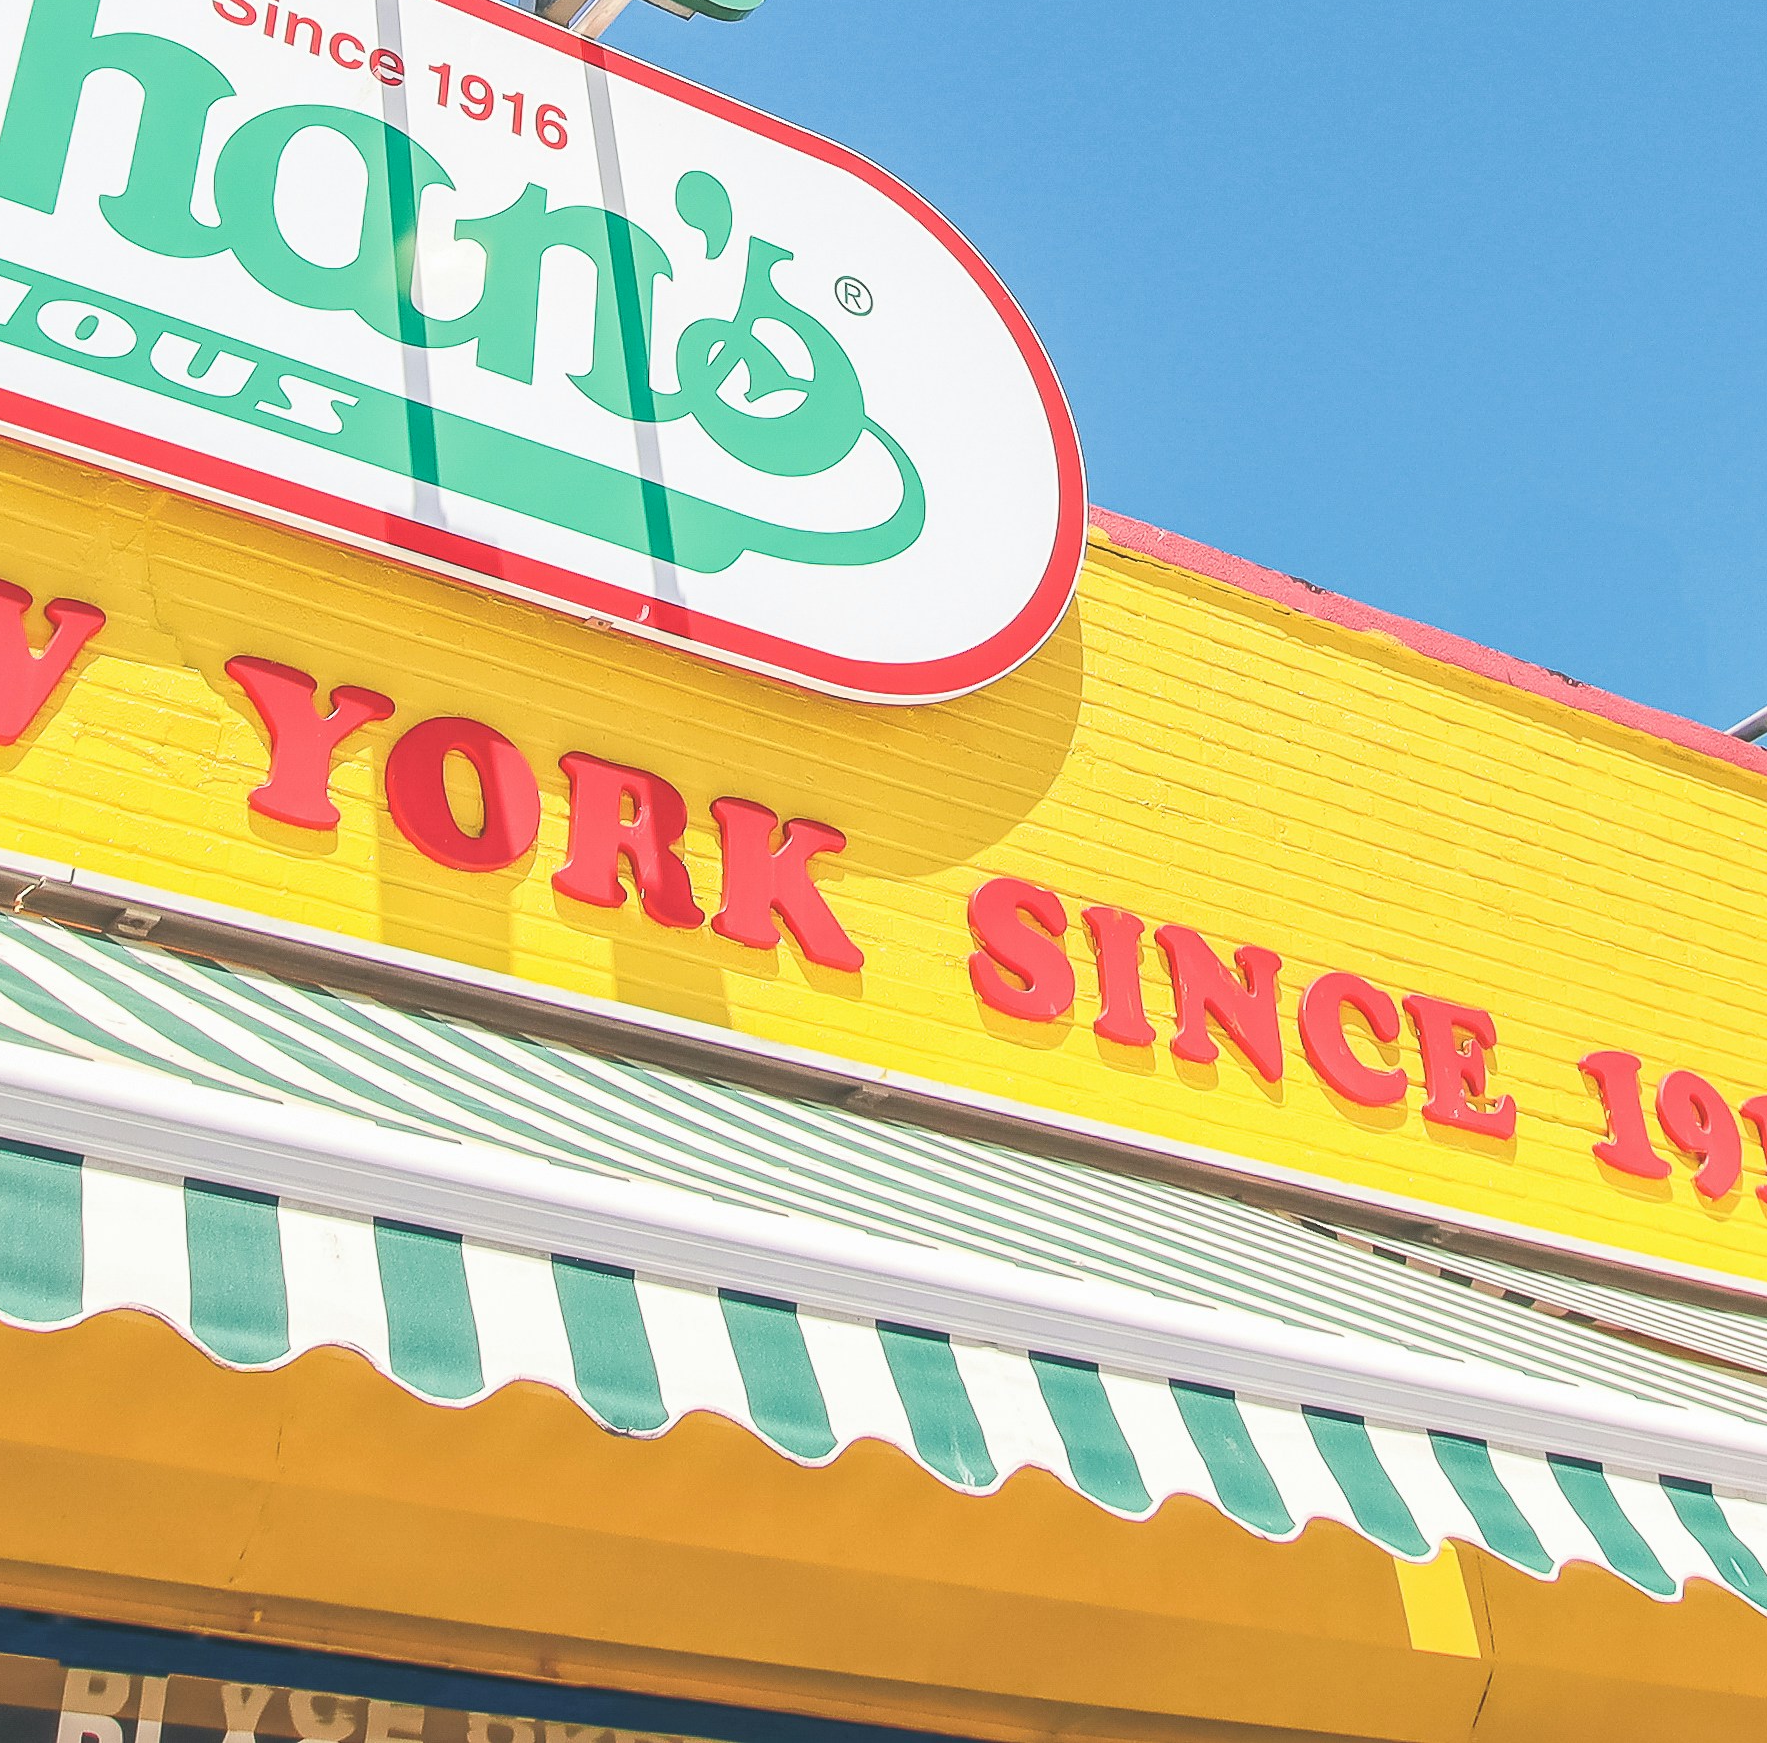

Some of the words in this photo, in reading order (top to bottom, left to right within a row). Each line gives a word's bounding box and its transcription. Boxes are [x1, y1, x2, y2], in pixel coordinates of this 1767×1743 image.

[427, 61, 569, 151] 1916
[225, 655, 865, 974] YORK
[967, 876, 1517, 1141] SINCE
